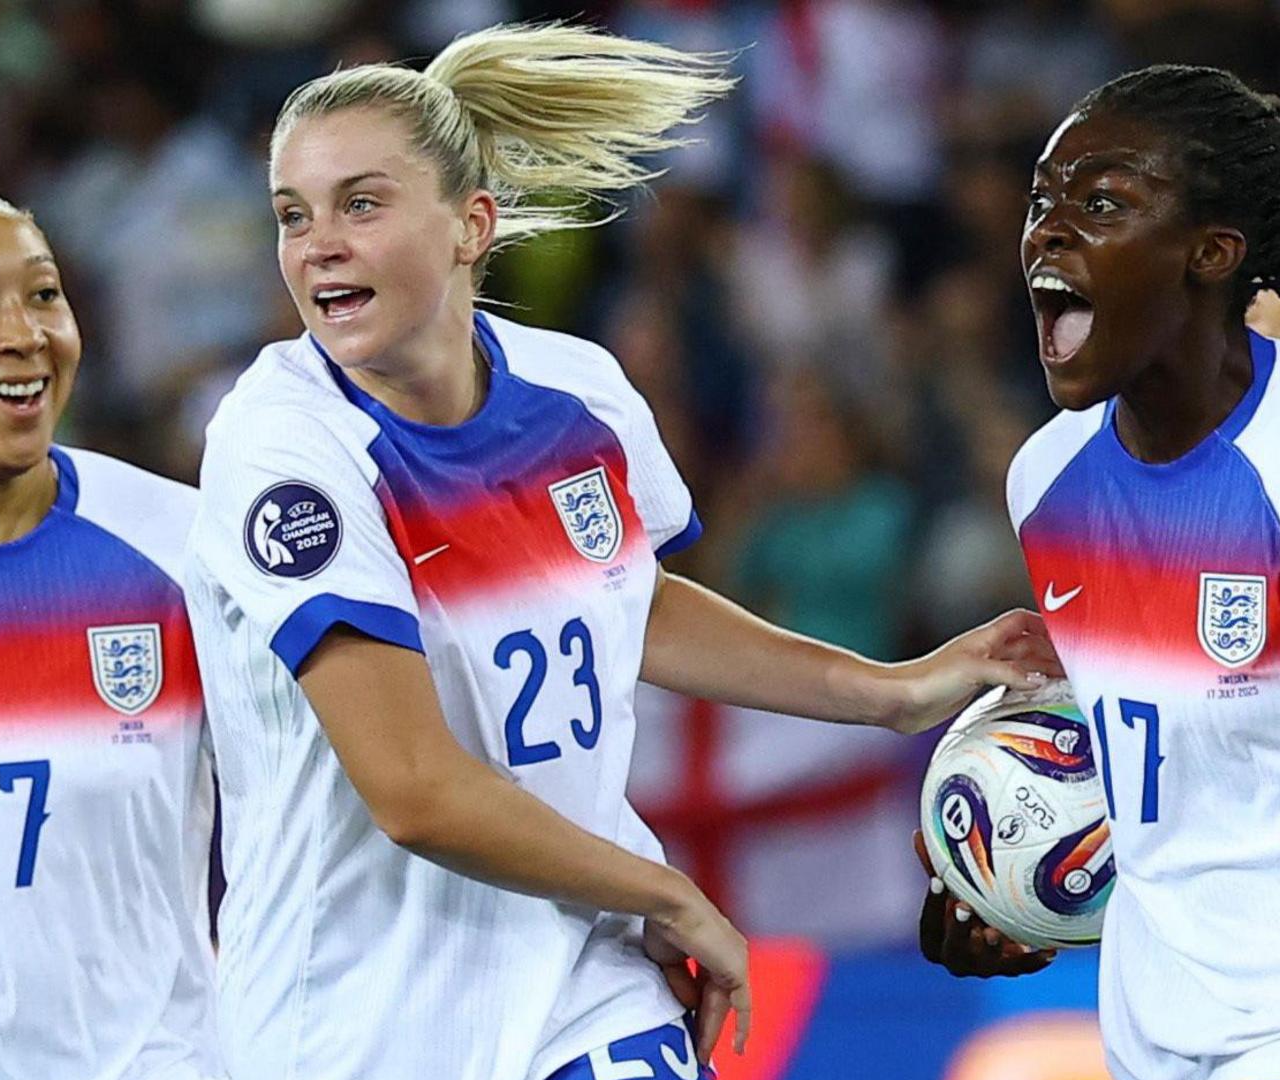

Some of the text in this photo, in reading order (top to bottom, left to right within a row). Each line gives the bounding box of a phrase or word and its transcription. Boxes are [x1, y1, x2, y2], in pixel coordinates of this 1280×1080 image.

[281, 512, 330, 532] EUROPEAN
[282, 519, 335, 542] CHAMPIONS
[296, 534, 327, 551] 2022
[493, 616, 602, 768] 23
[1092, 695, 1165, 824] 17
